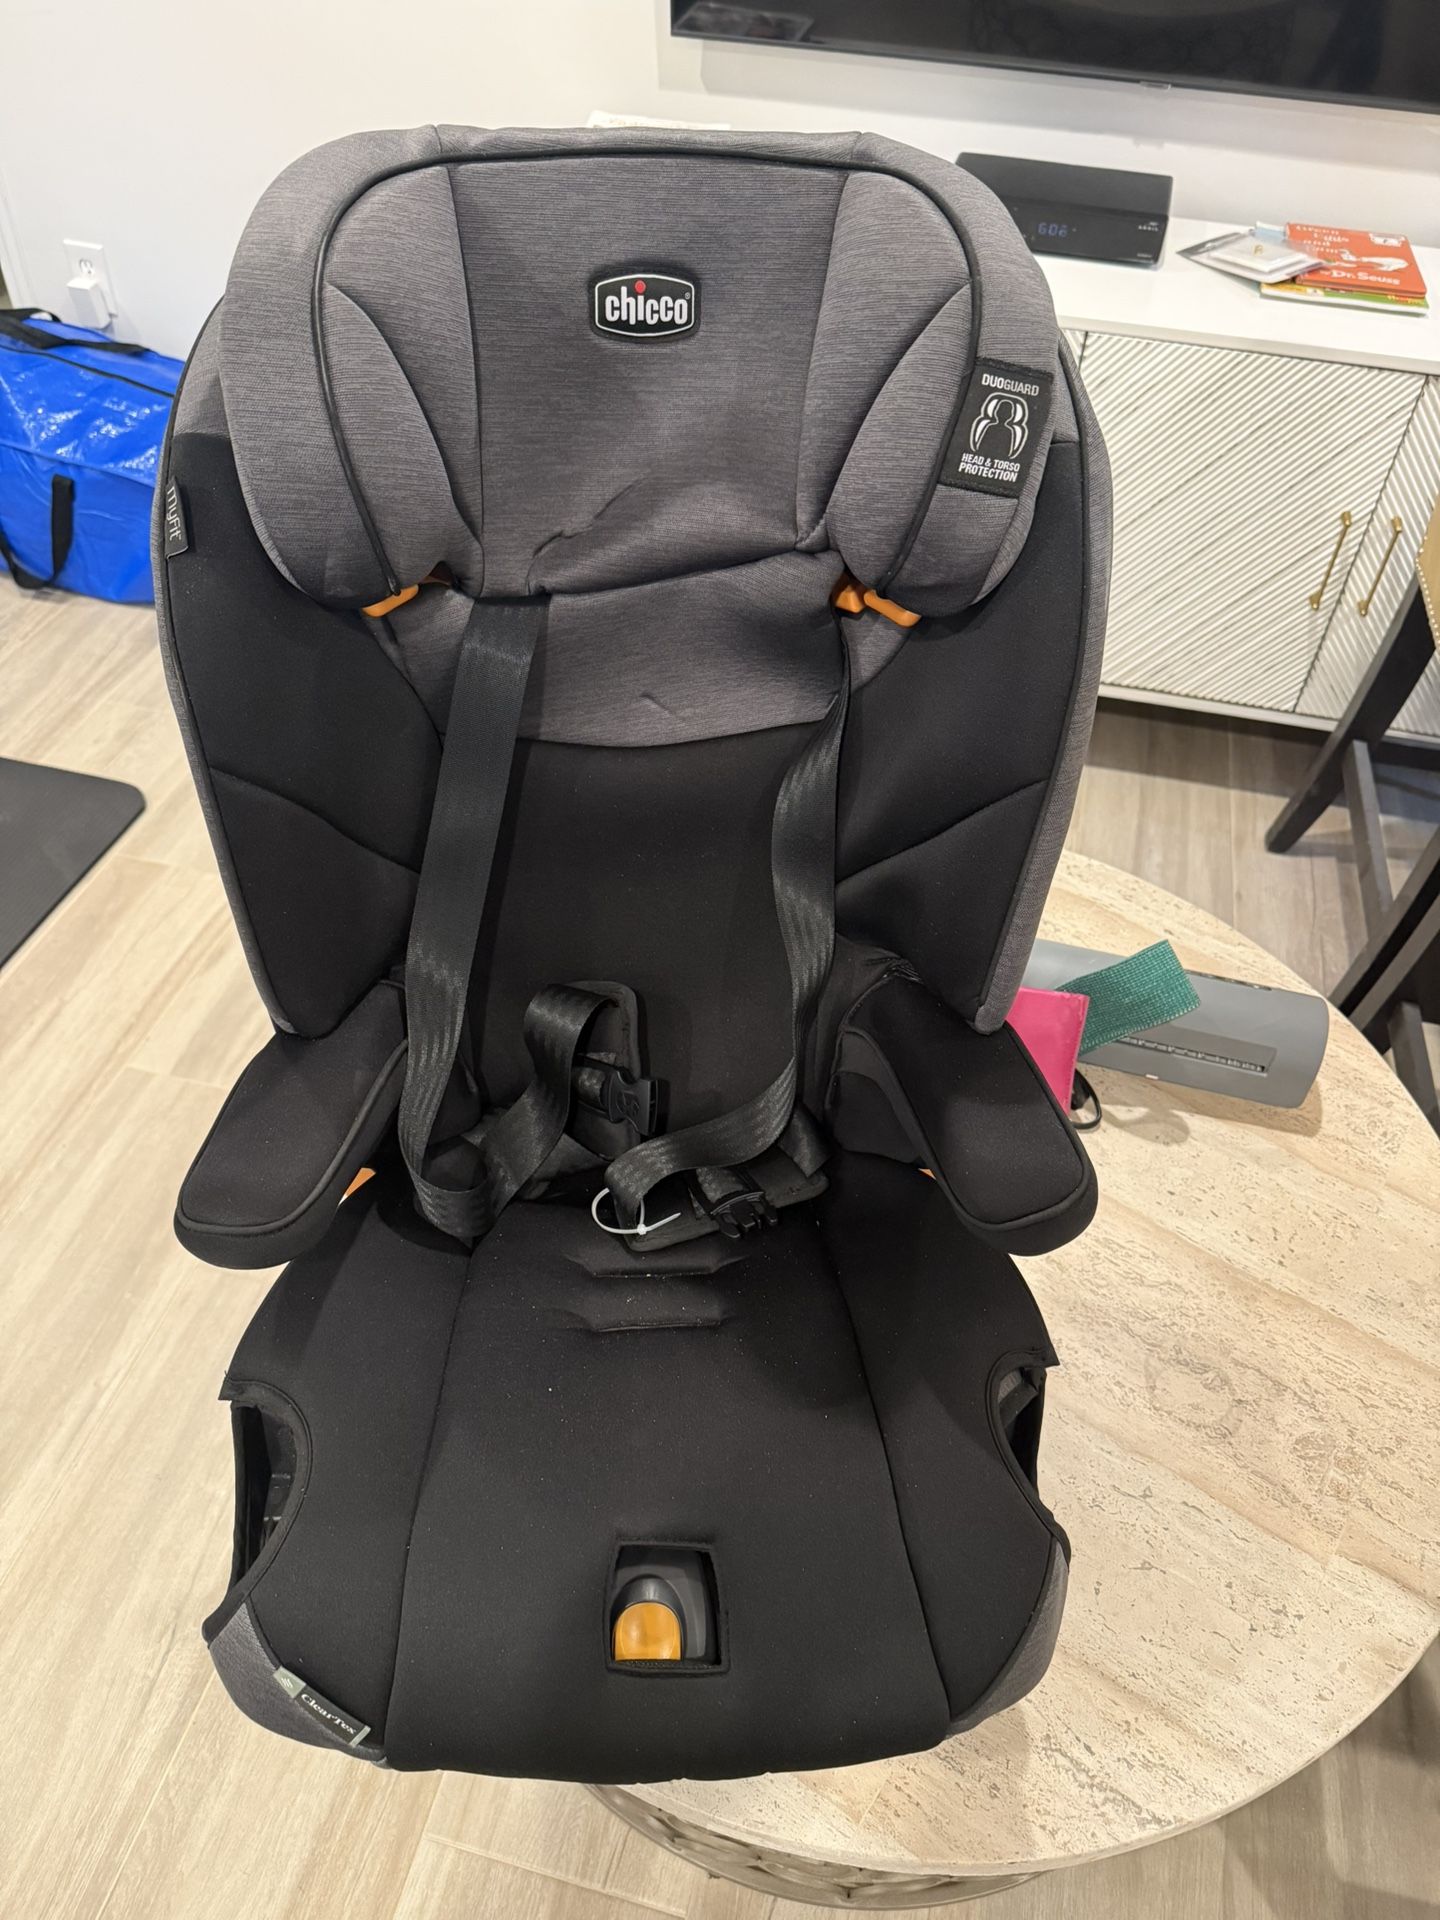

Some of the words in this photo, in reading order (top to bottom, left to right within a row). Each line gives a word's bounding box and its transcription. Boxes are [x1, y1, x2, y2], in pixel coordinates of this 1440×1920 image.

[1330, 269, 1356, 279] Dr.
[1357, 271, 1401, 285] Seuss
[605, 280, 688, 325] chicco
[981, 373, 1040, 396] DUOGUARD
[958, 462, 1018, 482] PROTECTION
[961, 452, 984, 465] HEAD
[984, 458, 992, 467] &
[993, 459, 1021, 472] TORSO
[301, 1694, 356, 1734] ClearTex
